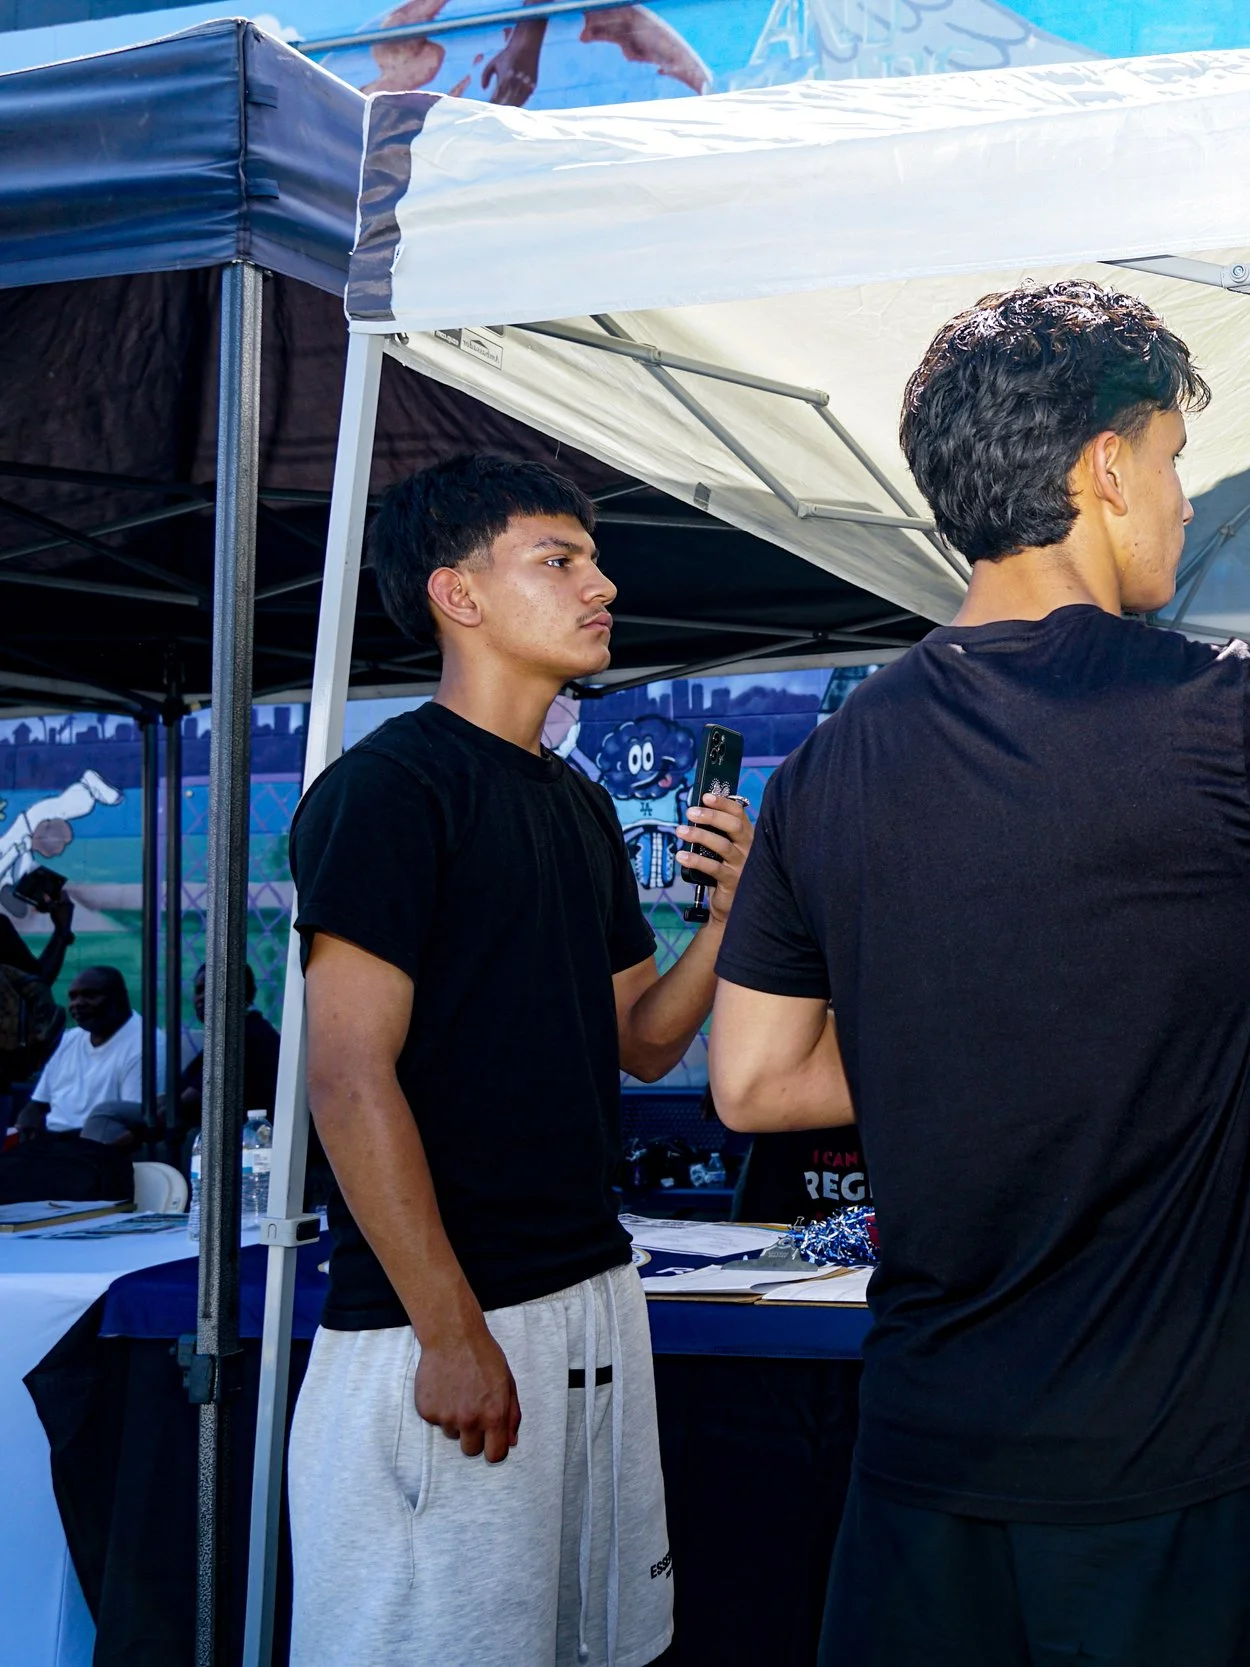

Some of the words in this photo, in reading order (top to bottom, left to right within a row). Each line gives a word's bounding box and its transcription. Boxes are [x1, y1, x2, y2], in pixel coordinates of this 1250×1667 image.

[813, 1150, 819, 1165] I
[823, 1150, 858, 1167] CAN
[804, 1171, 874, 1200] REG
